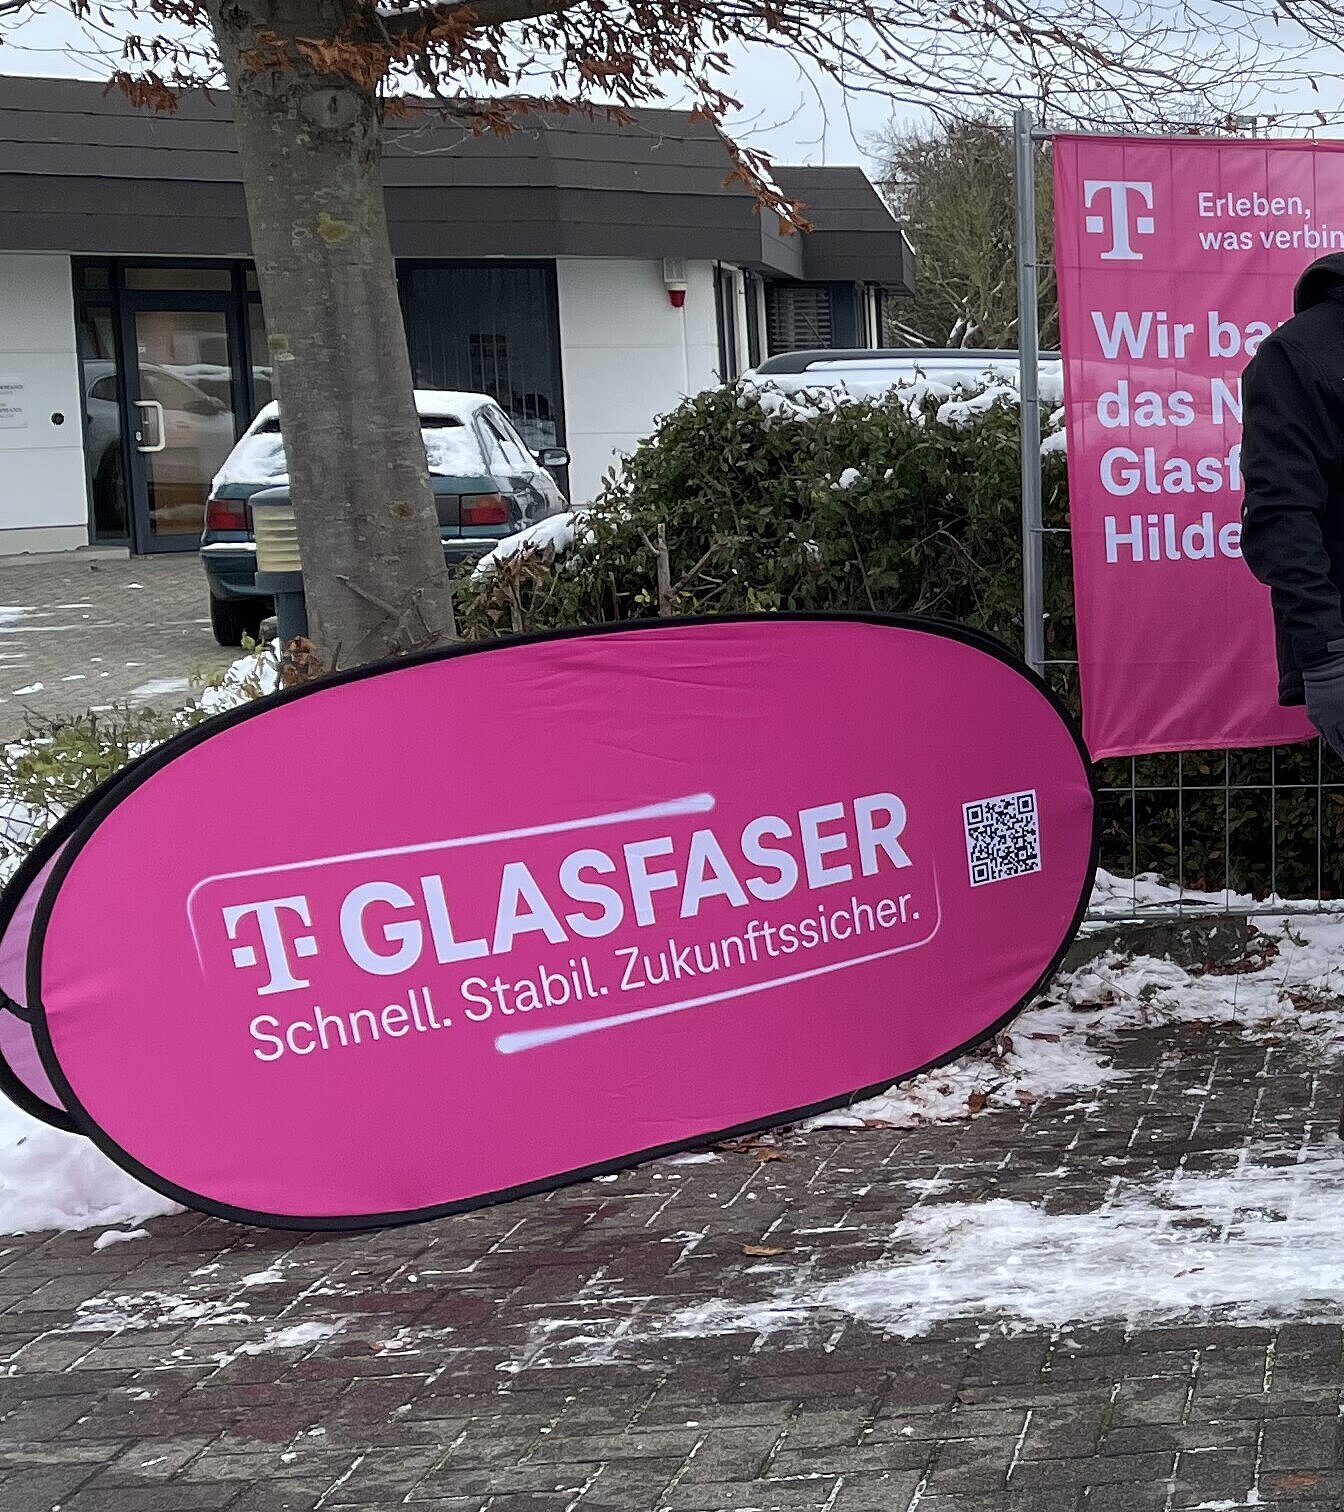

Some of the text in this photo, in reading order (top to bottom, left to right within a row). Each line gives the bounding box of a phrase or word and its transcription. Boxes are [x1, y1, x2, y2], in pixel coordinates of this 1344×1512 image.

[1198, 191, 1311, 219] Erleben,
[1199, 231, 1253, 250] was
[1090, 310, 1194, 360] Wir
[1096, 379, 1196, 428] das
[1099, 444, 1244, 497] Glasf
[1103, 511, 1243, 564] Hilde
[337, 791, 913, 976] GLASFASER
[248, 887, 922, 1063] Schnell. Stabil. Zukunftssicher.
